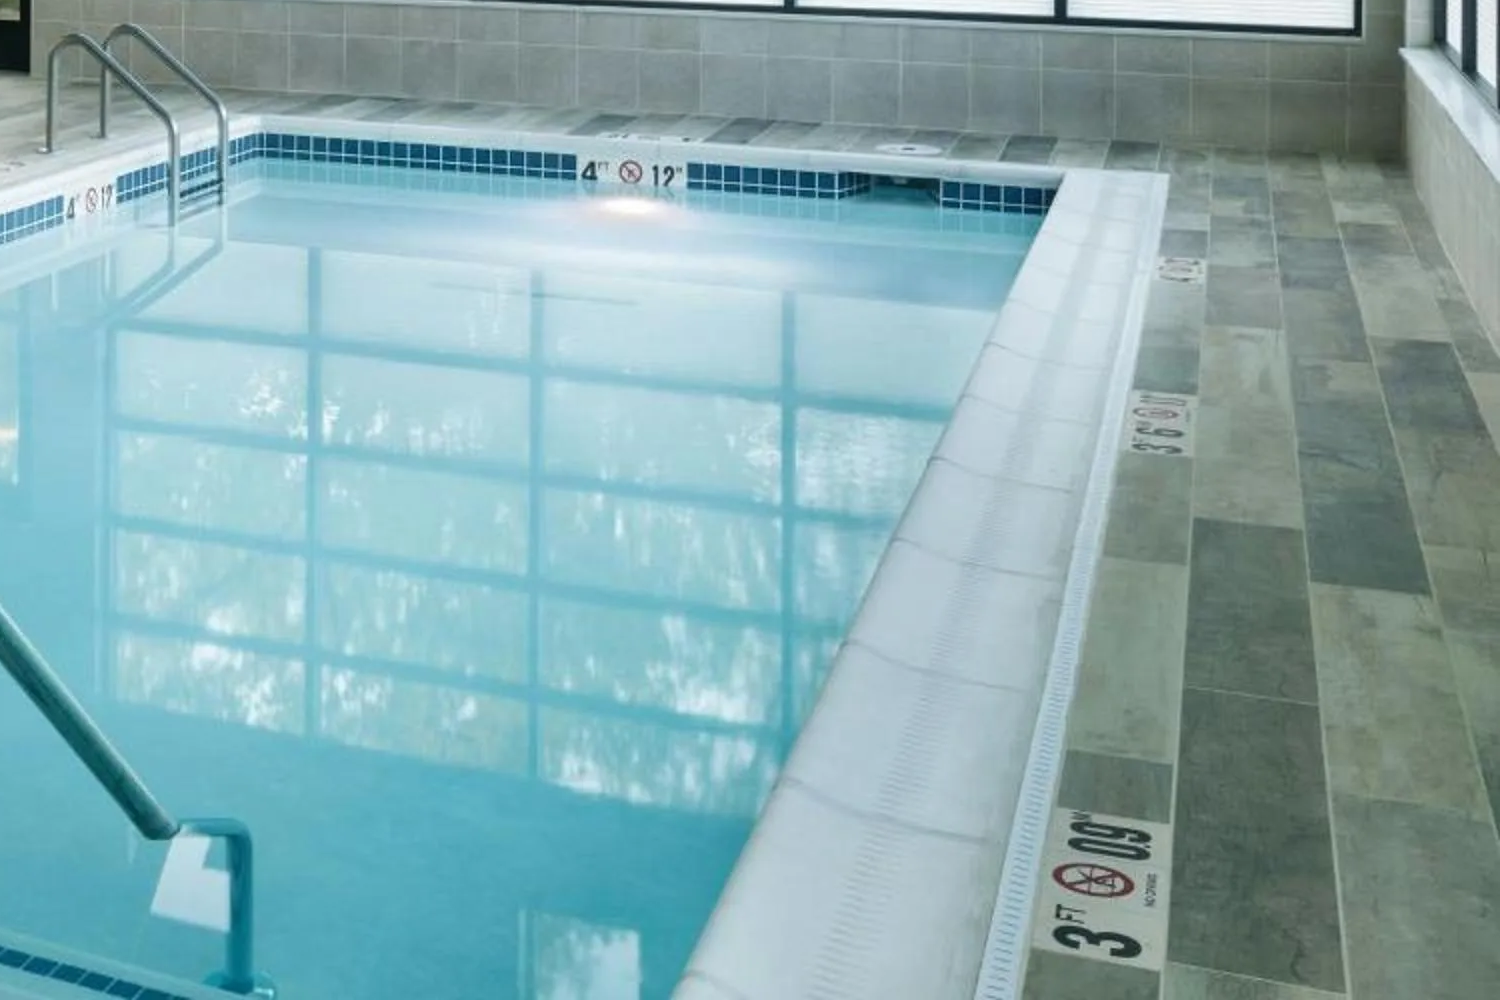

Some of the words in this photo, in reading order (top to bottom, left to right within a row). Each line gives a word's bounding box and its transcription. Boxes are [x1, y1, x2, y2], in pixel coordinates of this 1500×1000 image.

[581, 161, 598, 180] 4
[1054, 903, 1088, 925] FT
[1052, 925, 1143, 959] 3
